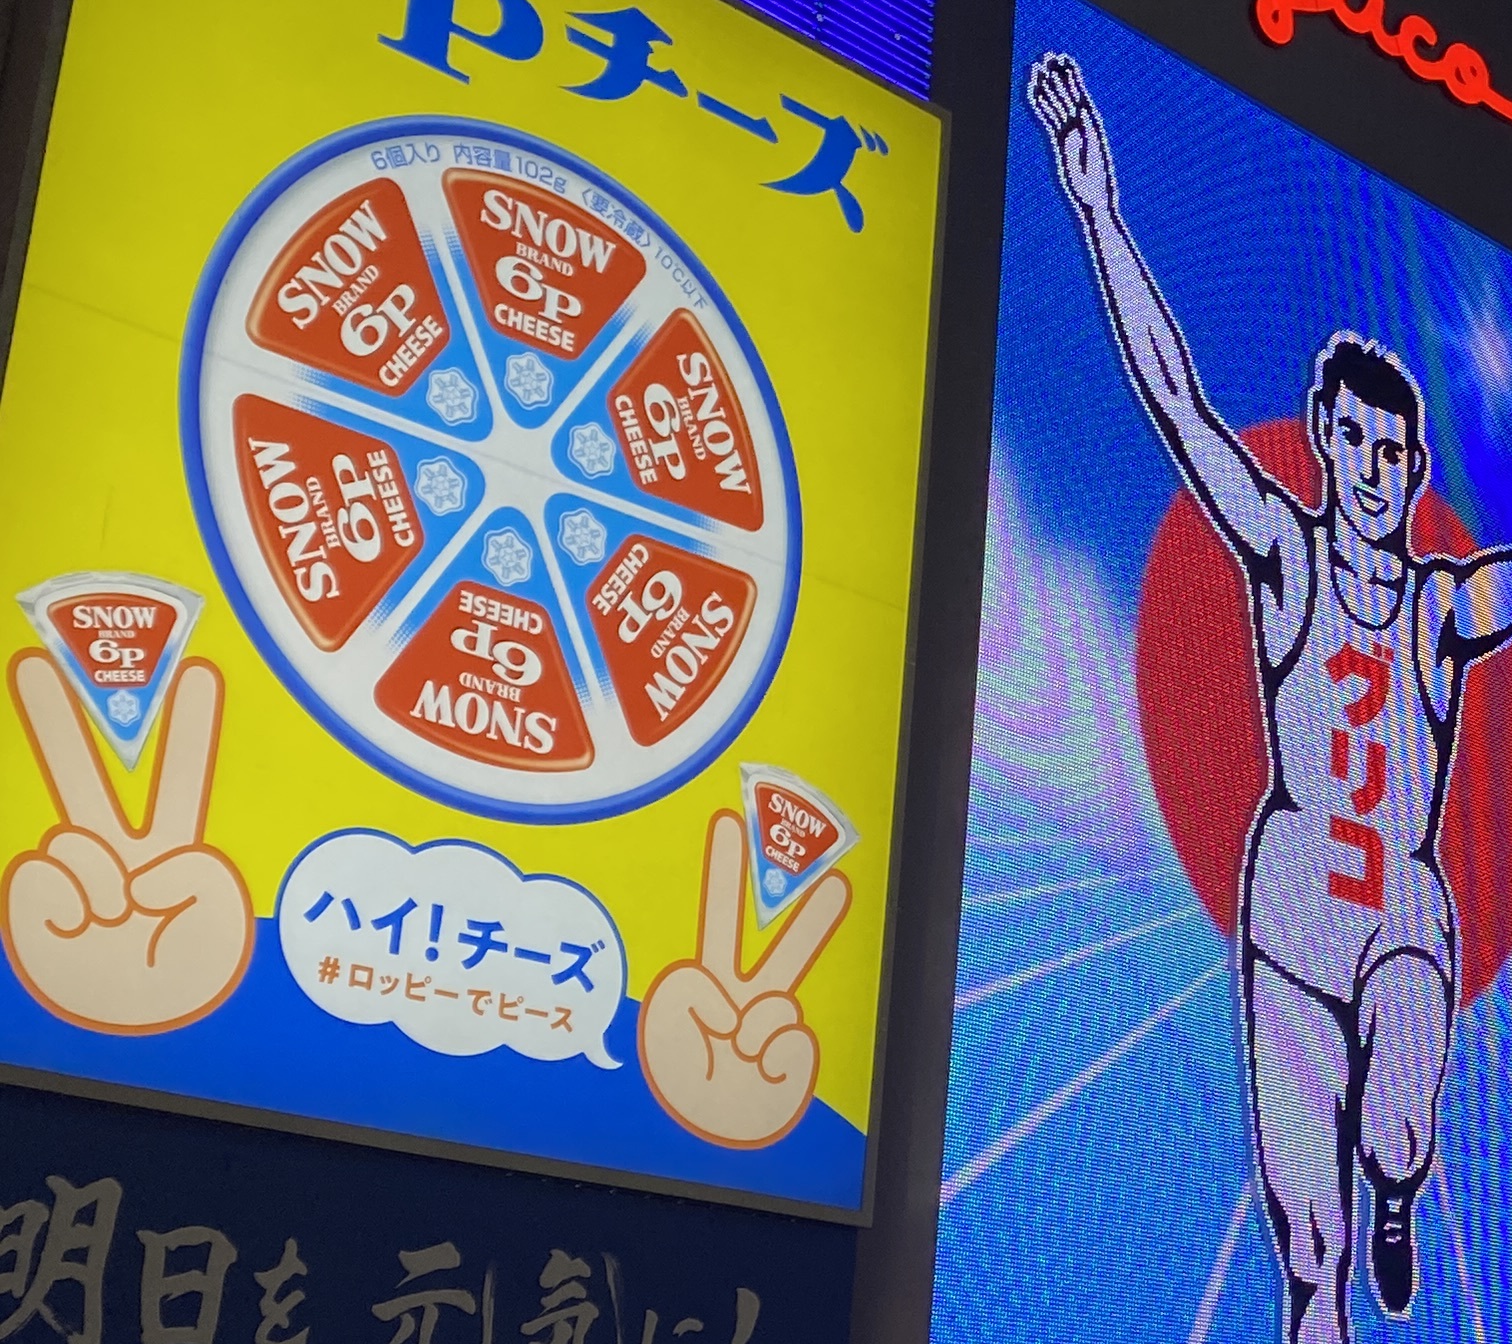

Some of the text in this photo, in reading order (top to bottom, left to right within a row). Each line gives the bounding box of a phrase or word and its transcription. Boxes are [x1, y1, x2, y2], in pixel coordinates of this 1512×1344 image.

[371, 142, 441, 171] 6個入り
[277, 199, 389, 331] SNOW
[481, 189, 616, 274] SNOW
[515, 241, 575, 277] BRAND
[332, 264, 380, 316] BRAND
[341, 282, 416, 356] 6P
[495, 256, 582, 324] 6P
[378, 315, 443, 388] CHEESE
[494, 303, 577, 353] CHEESE
[614, 394, 657, 487] CHEESE
[642, 383, 687, 482] 6P
[677, 352, 752, 497] SNOW
[677, 396, 708, 462] BRAND
[247, 436, 340, 603] SNOW
[306, 474, 340, 550] BRAND
[336, 453, 383, 563] 6P
[370, 447, 416, 549] CHEESE
[459, 590, 543, 636] CHEESE
[591, 542, 651, 616] CHEESE
[617, 570, 683, 645] 6P
[72, 605, 157, 630] SNOW
[650, 607, 690, 659] BRAND
[88, 638, 145, 668] 6P
[93, 669, 146, 683] CHEESE
[450, 620, 543, 687] 6P
[459, 671, 522, 704] BRAND
[643, 591, 735, 723] SNOW
[410, 679, 558, 754] SNOW
[1326, 642, 1394, 909] グリコ
[768, 791, 827, 838] SNOW
[769, 823, 806, 858] 6P
[764, 844, 800, 873] CHEESE
